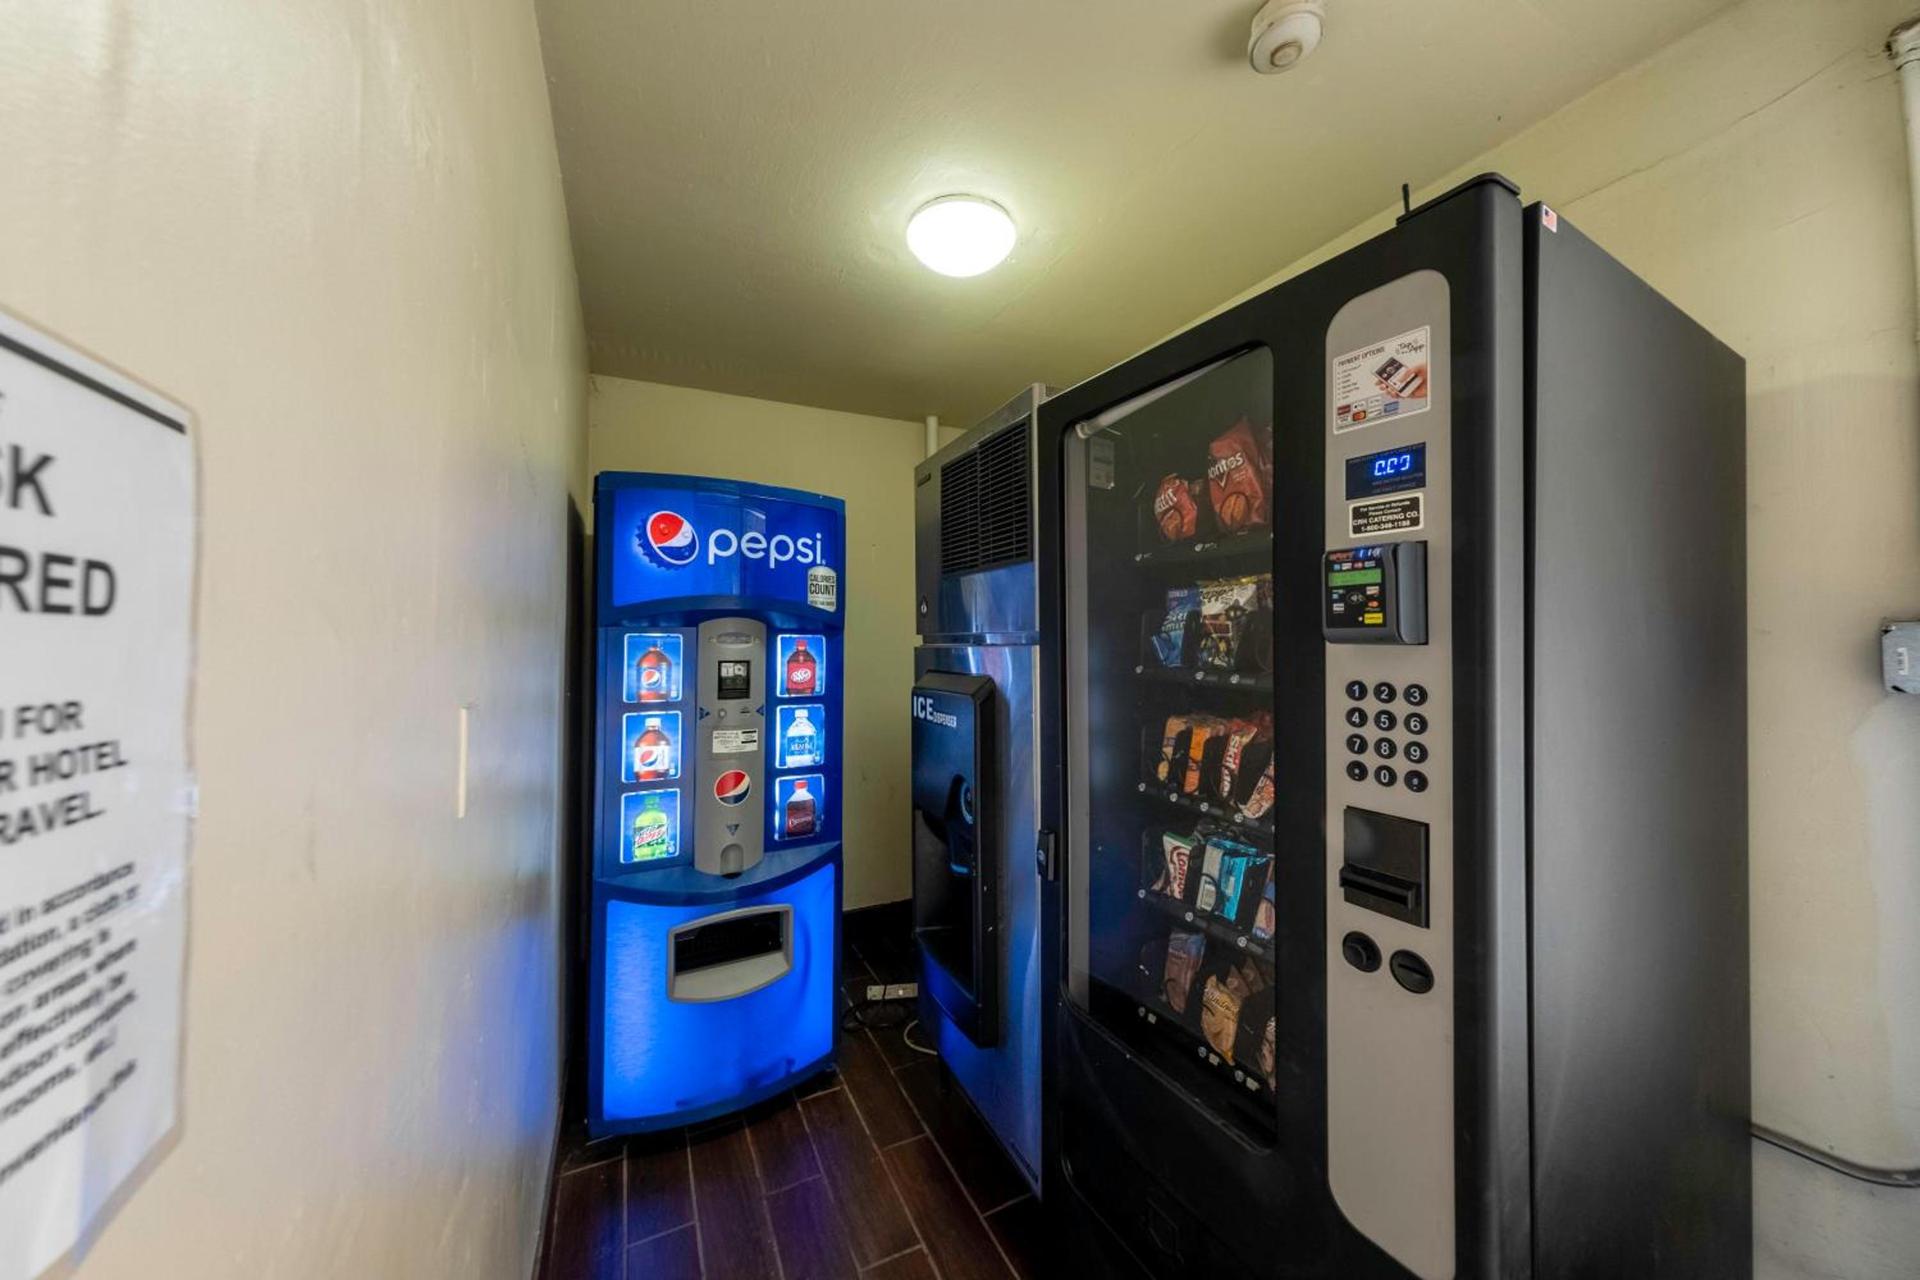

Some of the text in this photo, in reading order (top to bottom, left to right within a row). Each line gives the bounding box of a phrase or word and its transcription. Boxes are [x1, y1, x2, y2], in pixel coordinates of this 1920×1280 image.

[0, 443, 55, 518] K
[1369, 513, 1405, 524] CATERING
[708, 528, 822, 569] pepsi
[809, 582, 836, 596] COUNT
[1352, 684, 1420, 702] 1 2 3
[913, 695, 933, 720] ICE
[15, 701, 84, 739] FOR
[1351, 711, 1420, 731] 4 5 6
[1352, 738, 1420, 760] 7 8 9
[28, 740, 128, 786] HOTEL
[1380, 769, 1389, 783] 0
